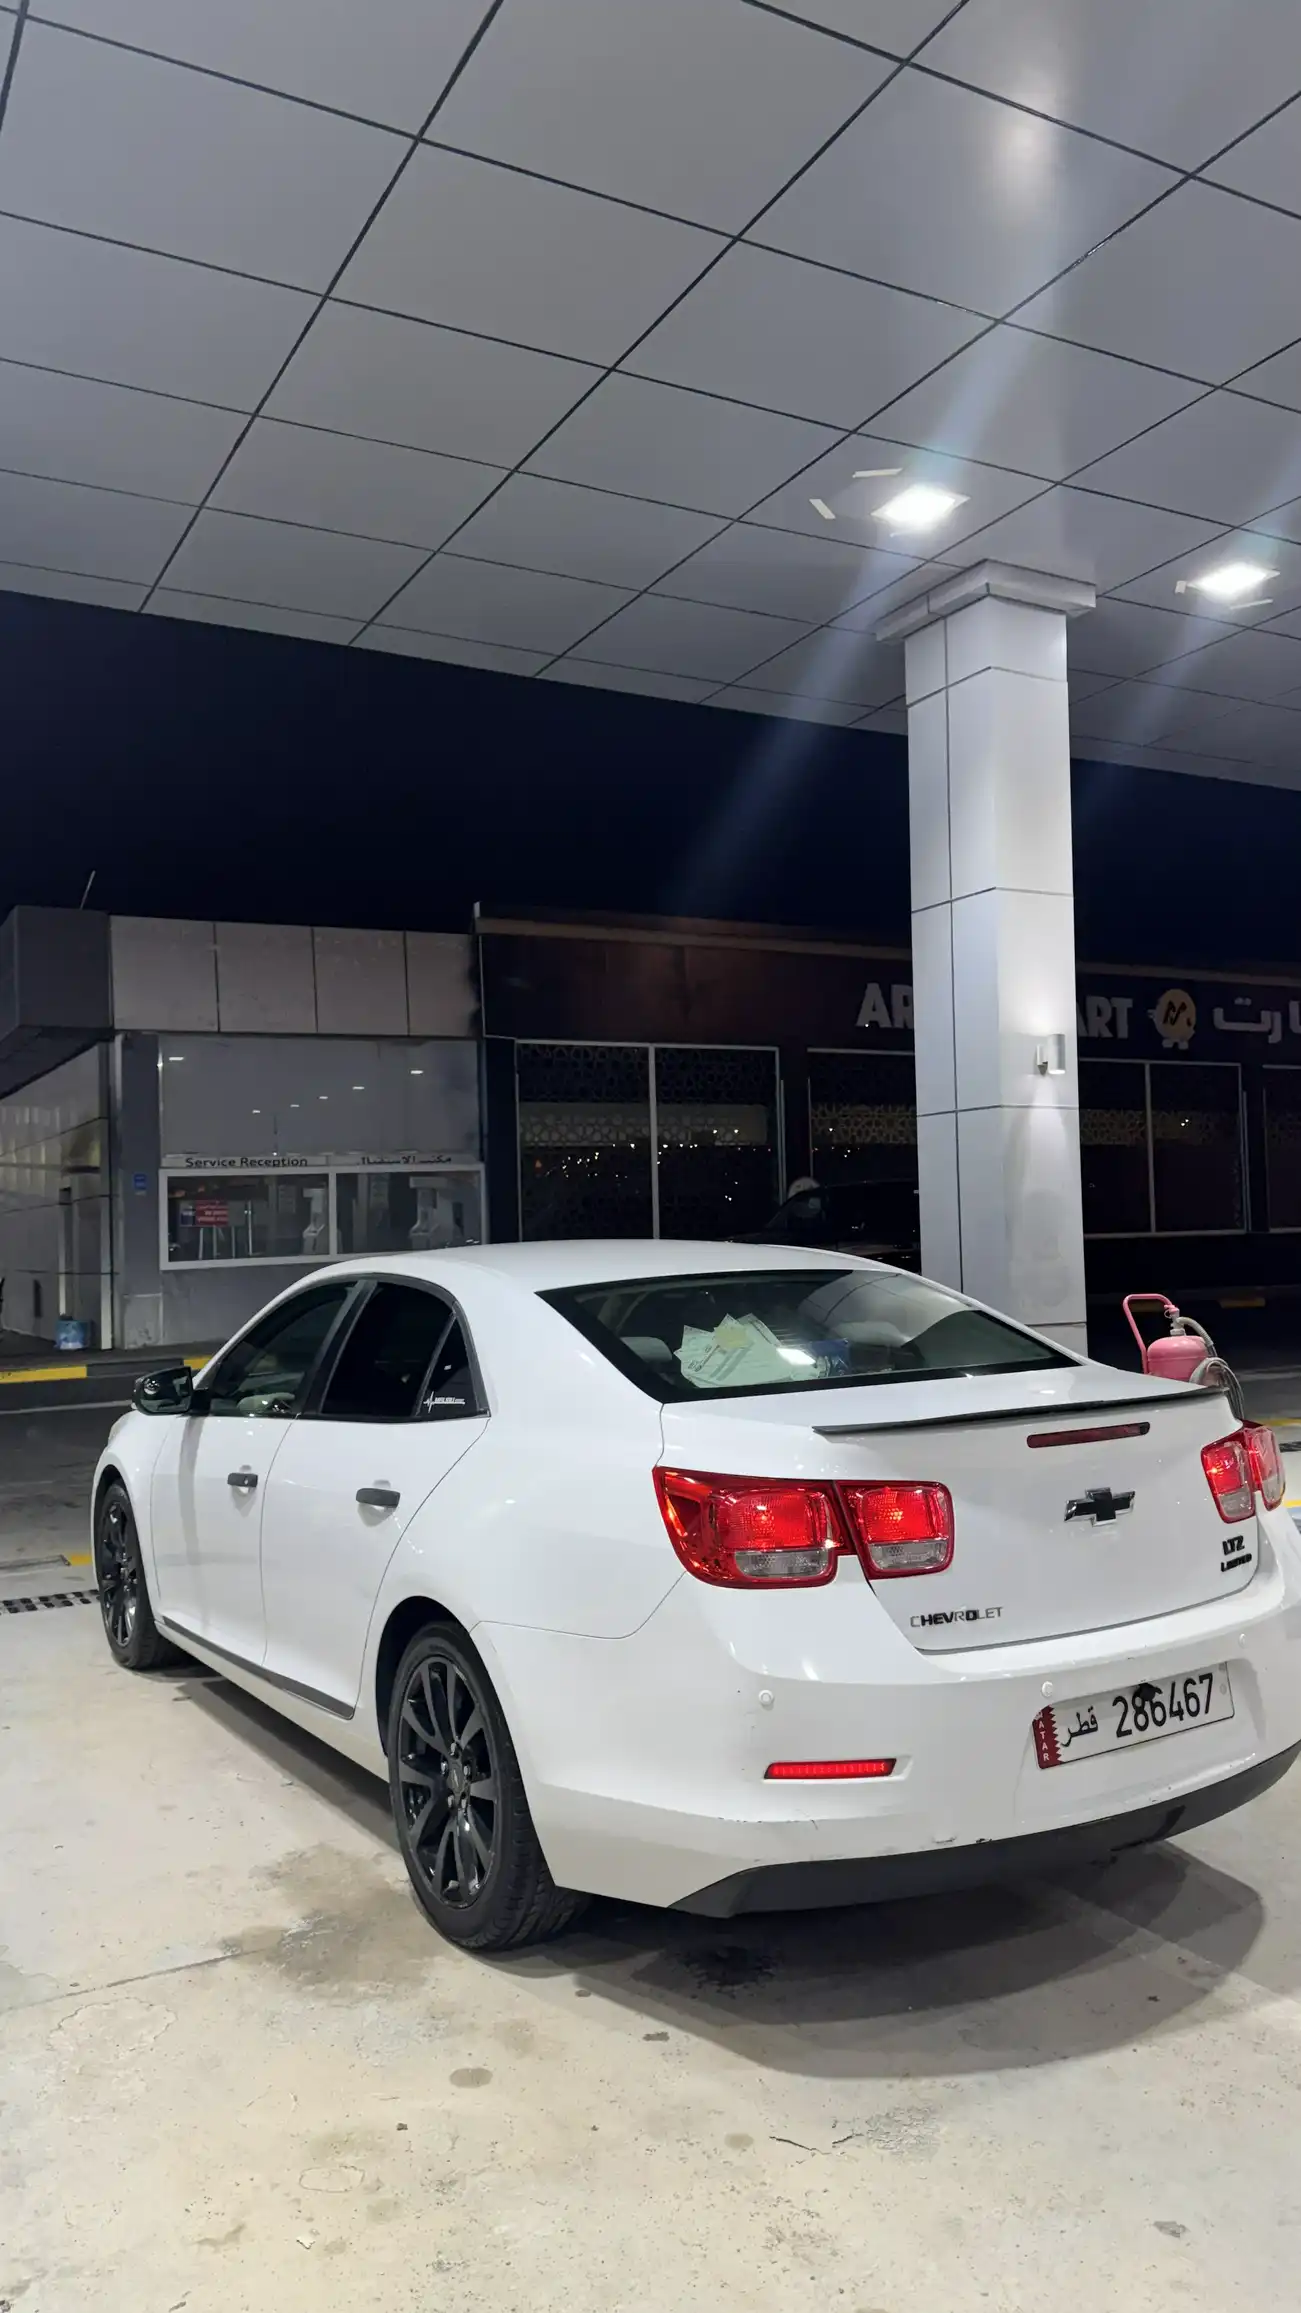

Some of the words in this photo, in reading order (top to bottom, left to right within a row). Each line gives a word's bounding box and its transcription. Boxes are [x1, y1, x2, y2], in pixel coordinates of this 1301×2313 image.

[185, 1157, 236, 1169] Service
[240, 1157, 308, 1168] Reception
[1222, 1535, 1245, 1556] LTZ
[910, 1606, 1003, 1627] CHEVROLET
[1112, 1672, 1213, 1738] 286467
[1061, 1705, 1098, 1747] قطر
